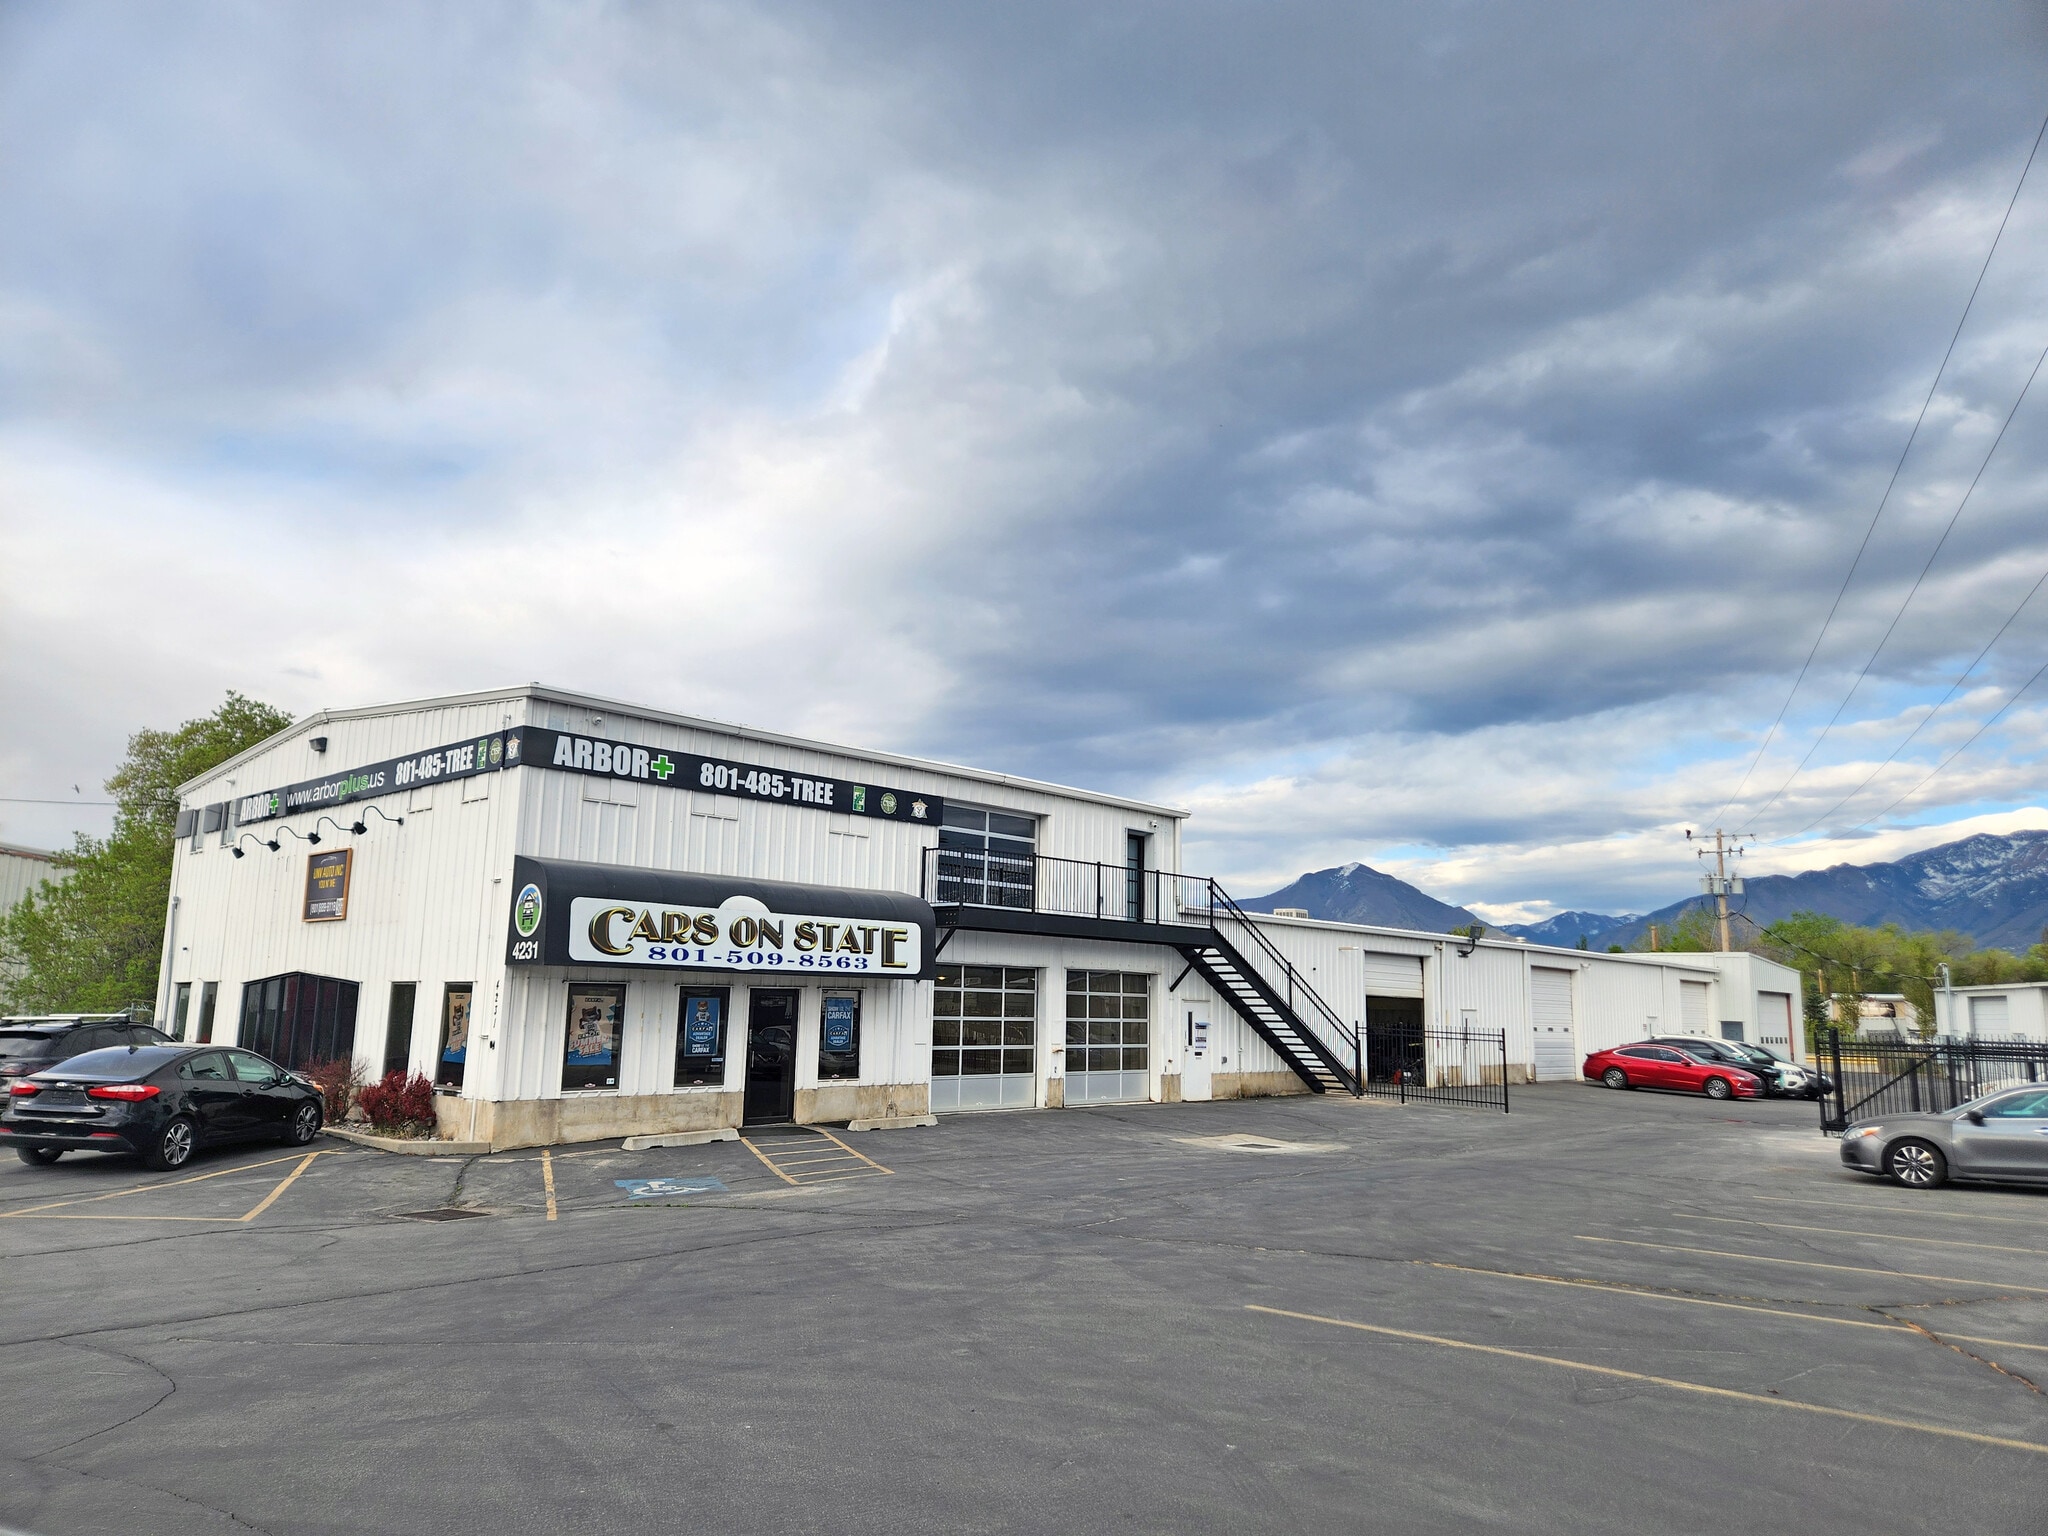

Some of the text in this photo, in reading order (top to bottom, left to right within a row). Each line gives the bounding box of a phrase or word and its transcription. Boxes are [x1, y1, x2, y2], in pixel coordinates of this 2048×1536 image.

[286, 771, 385, 807] www.arborplus.us
[395, 745, 474, 786] 801-485-TREE
[699, 762, 834, 806] 801-485-TREE
[512, 940, 539, 961] 4231
[588, 906, 909, 968] CARS ON STATE
[648, 946, 869, 970] 801-509-8563
[827, 1011, 851, 1020] CARFAX
